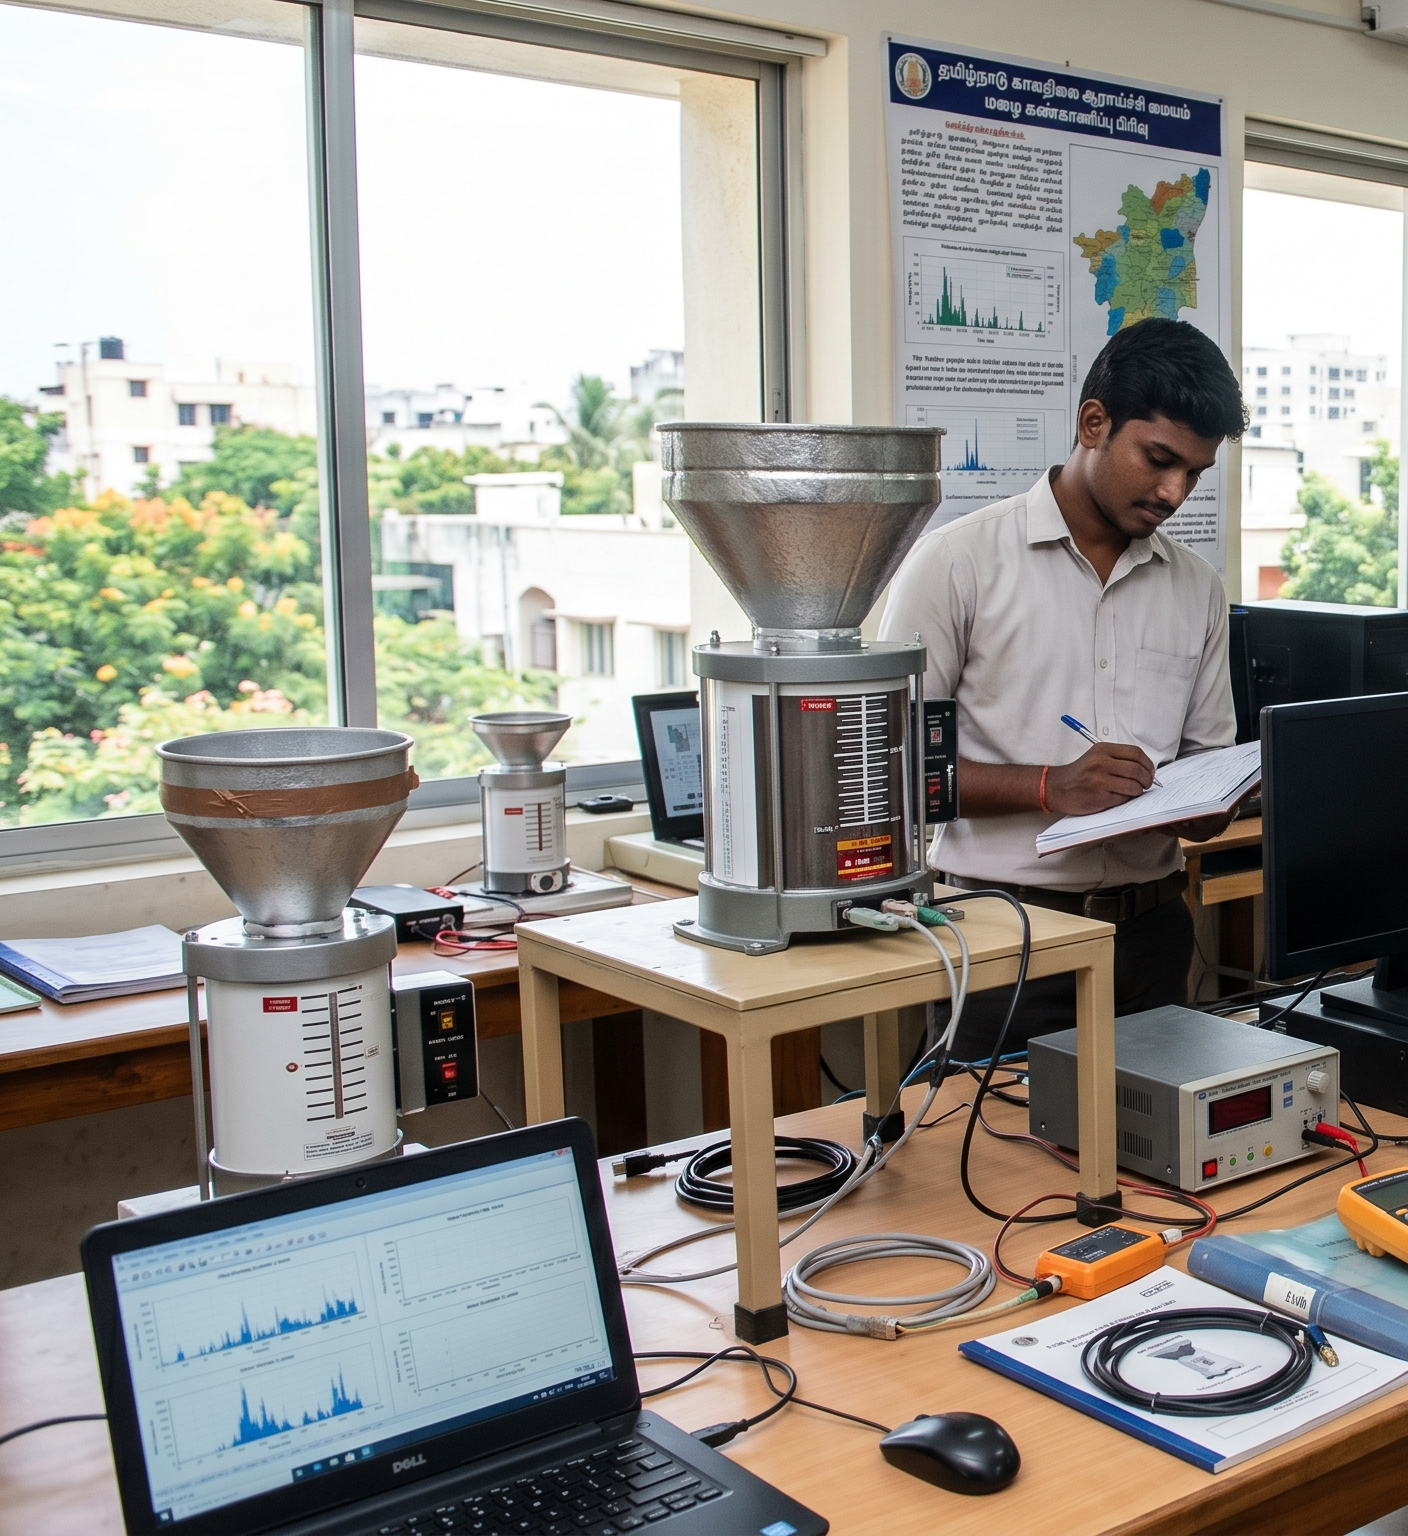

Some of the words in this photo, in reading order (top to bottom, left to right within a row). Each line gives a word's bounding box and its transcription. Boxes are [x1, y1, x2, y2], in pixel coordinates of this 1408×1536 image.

[938, 62, 1008, 91] தமிழ்நாடு
[1148, 103, 1191, 120] மையம்
[1116, 115, 1149, 140] பிரிவு
[392, 1453, 427, 1474] DELL
